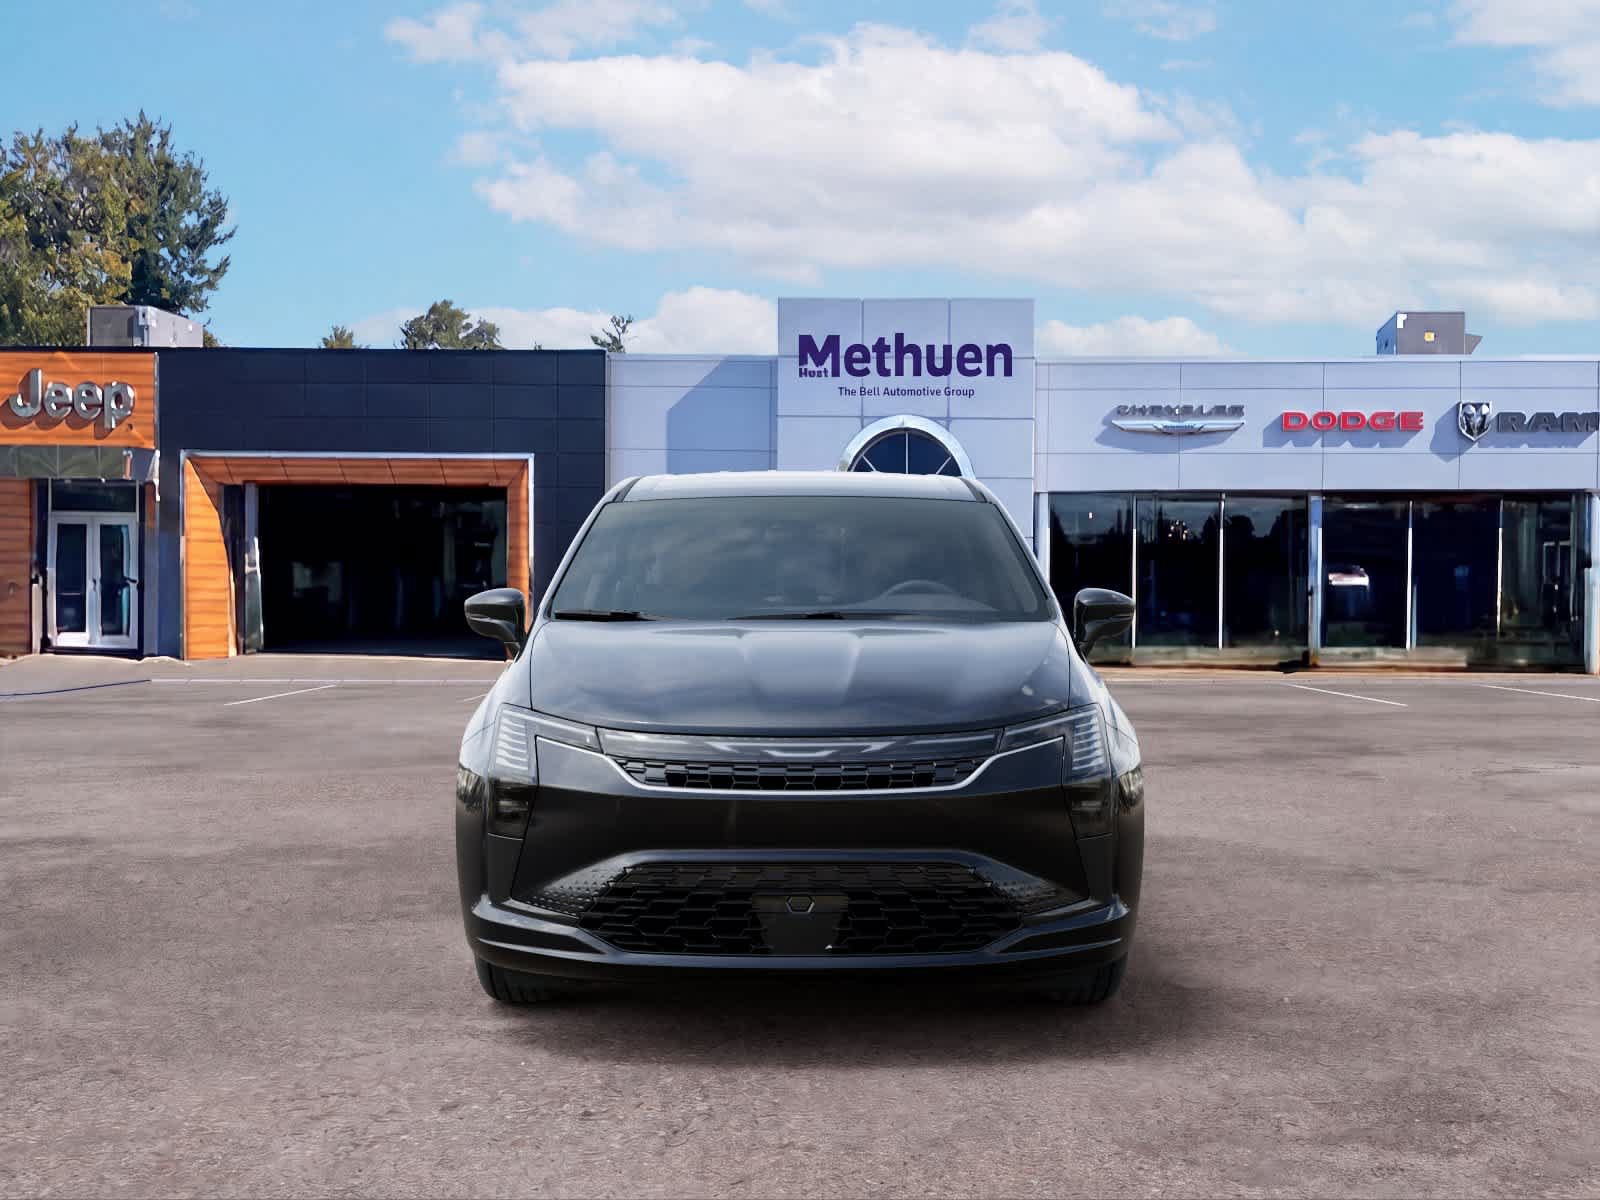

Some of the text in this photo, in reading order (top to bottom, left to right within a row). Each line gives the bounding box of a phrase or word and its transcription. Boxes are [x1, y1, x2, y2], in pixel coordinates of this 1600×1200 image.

[799, 333, 1012, 377] Methuen
[9, 368, 135, 429] Jeep
[838, 386, 975, 398] The Bell Automotive Group
[1282, 411, 1424, 431] DODGE
[1498, 411, 1600, 432] RAM
